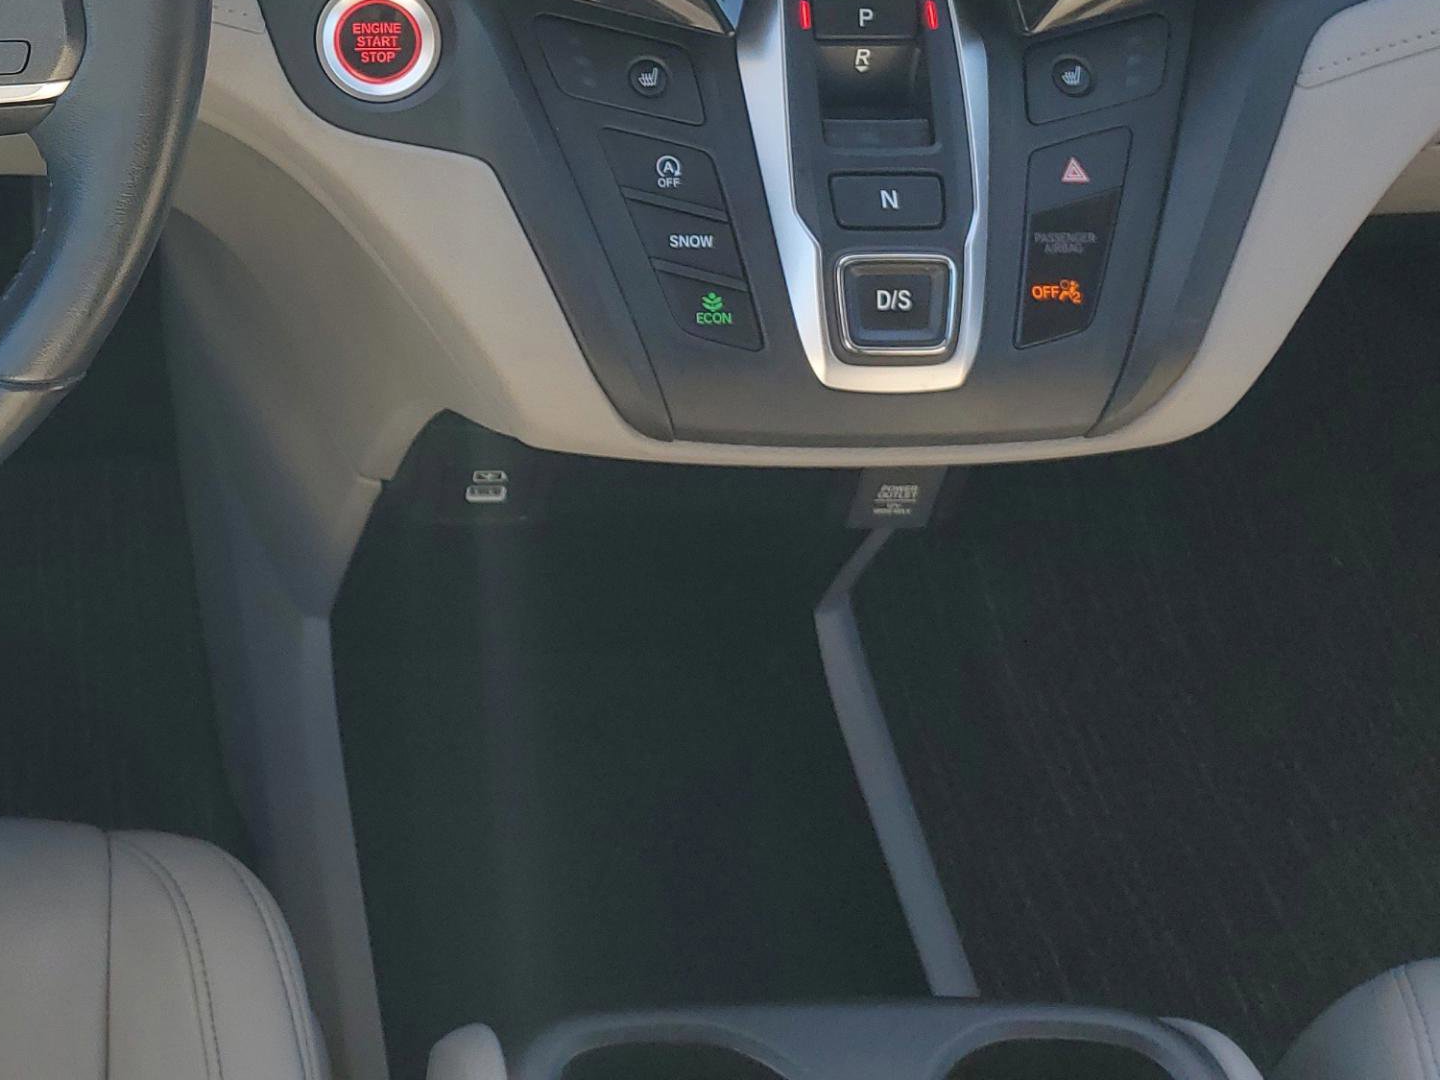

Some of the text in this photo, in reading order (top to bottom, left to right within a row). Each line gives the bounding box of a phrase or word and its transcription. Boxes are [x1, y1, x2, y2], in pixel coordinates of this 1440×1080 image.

[858, 8, 874, 27] P
[352, 23, 402, 34] ENGINE
[356, 35, 399, 48] START
[360, 51, 396, 64] STOP
[854, 49, 872, 66] R
[657, 177, 681, 188] OFF
[880, 189, 900, 210] N
[669, 234, 714, 249] SNOW
[875, 289, 914, 311] D/S
[1031, 285, 1060, 301] OFF
[696, 312, 733, 325] ECON
